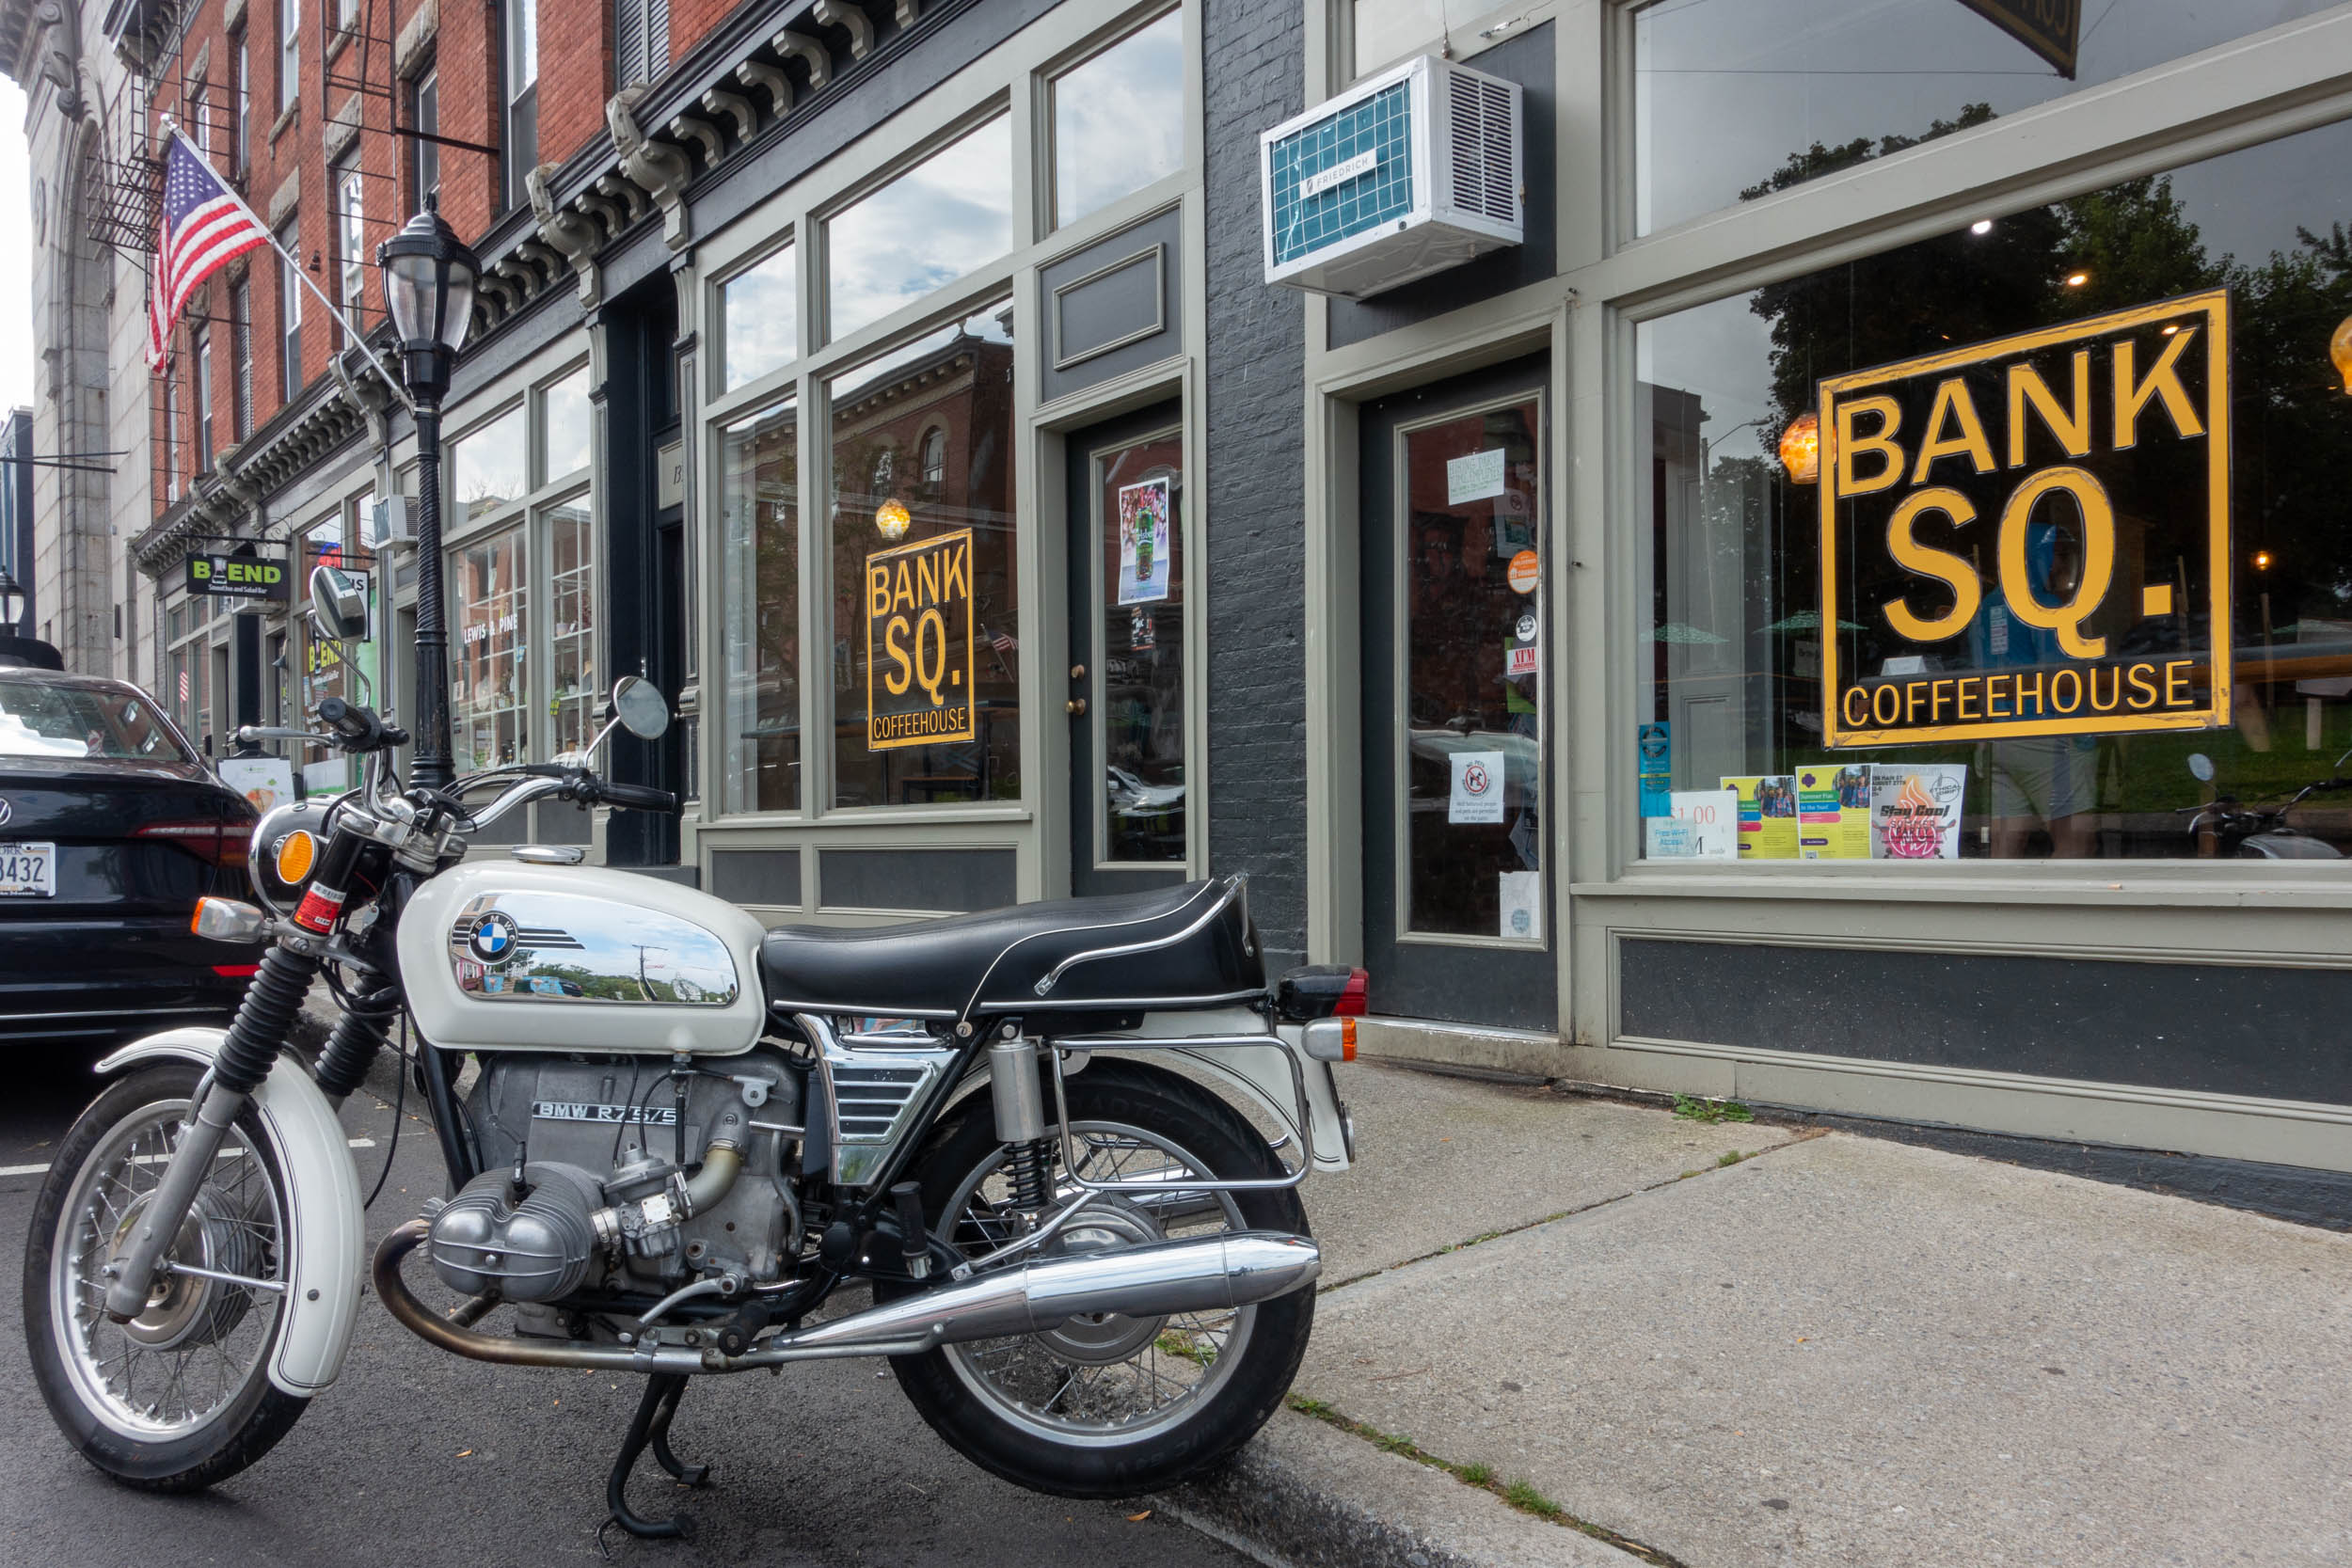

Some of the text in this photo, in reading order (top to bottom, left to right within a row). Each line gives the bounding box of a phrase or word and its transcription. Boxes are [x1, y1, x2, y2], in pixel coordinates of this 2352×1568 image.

[1317, 157, 1368, 186] FRIEDRICH
[1836, 325, 2207, 499] BANK
[674, 465, 684, 484] 13
[193, 559, 281, 584] BEND
[1883, 466, 2173, 659] SQ.
[870, 544, 967, 618] BANK
[464, 623, 486, 644] LEWIS
[499, 613, 517, 633] PINE
[309, 640, 342, 673] BEND
[884, 609, 960, 706] SQ.
[1514, 647, 1535, 663] ATM
[1843, 659, 2194, 728] COFFEEHOUSE
[873, 706, 966, 738] COFFEEHOUSE
[1880, 804, 1951, 819] Stay Cool
[1890, 819, 1935, 828] SUMMER
[1655, 828, 1670, 836] Free
[475, 914, 514, 931] BMW
[539, 1102, 676, 1122] BMW R75/5
